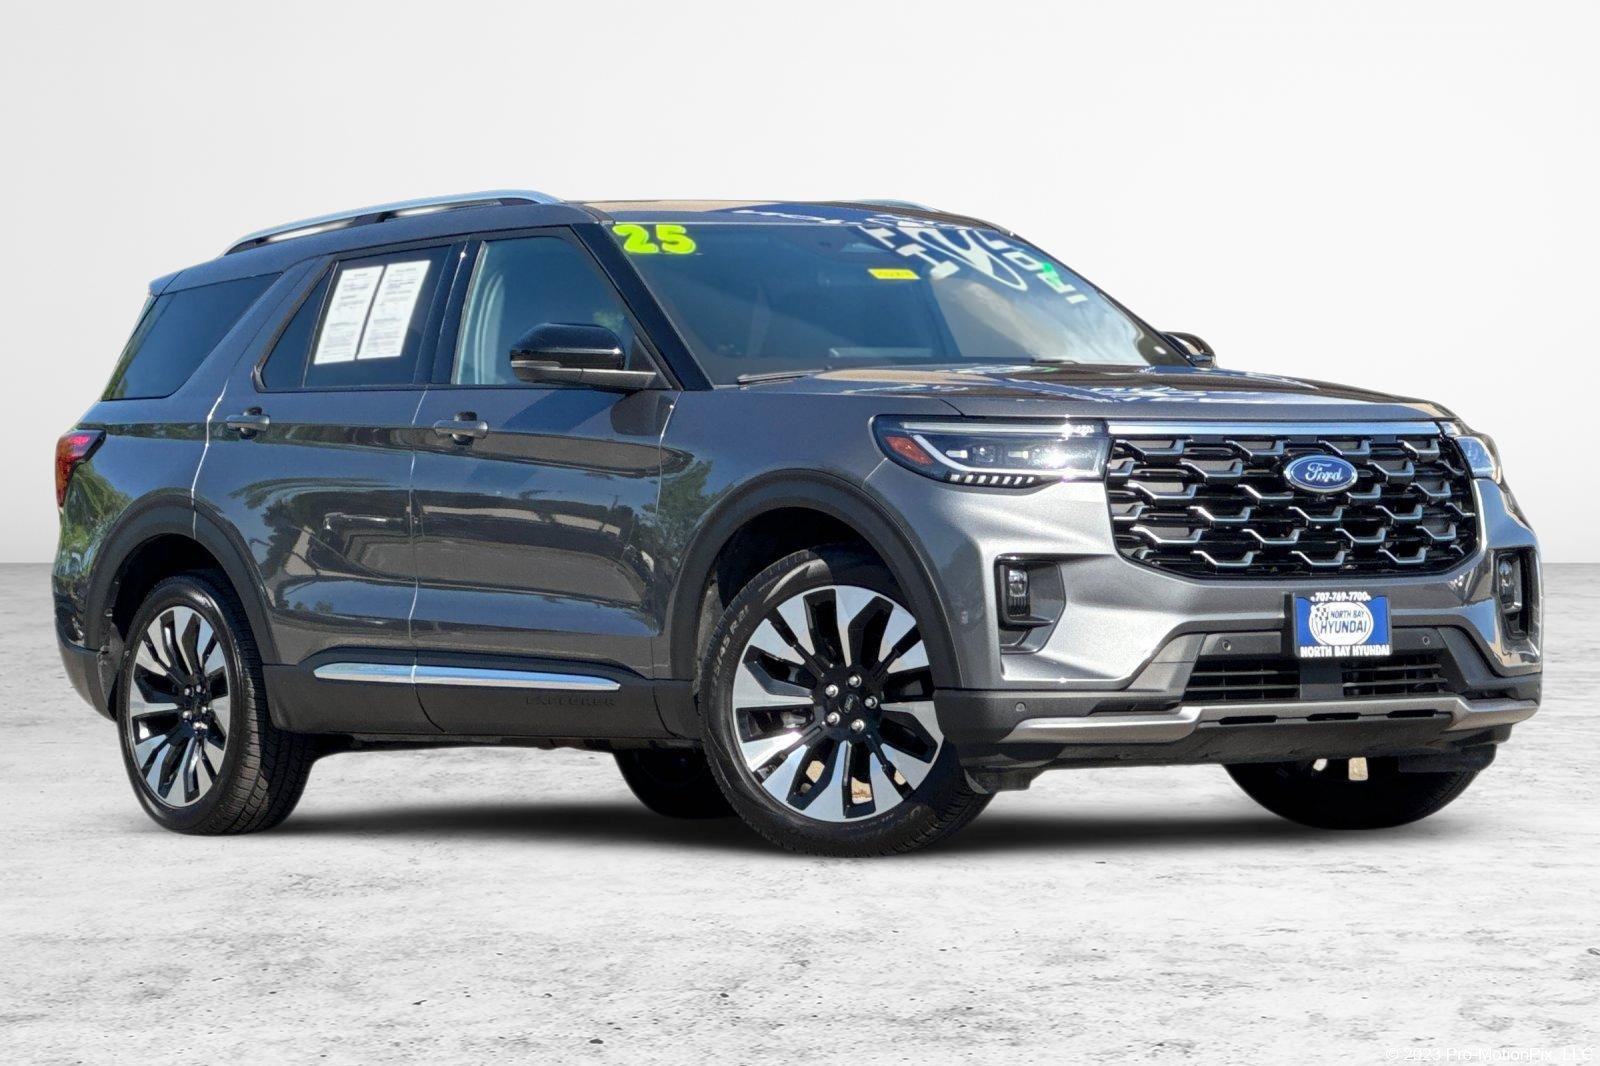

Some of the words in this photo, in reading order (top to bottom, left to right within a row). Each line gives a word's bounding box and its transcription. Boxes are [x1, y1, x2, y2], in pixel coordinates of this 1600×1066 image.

[612, 224, 697, 254] 25
[1305, 462, 1343, 482] Ford
[1330, 610, 1351, 618] NORTH
[1320, 620, 1367, 634] HYUNDAI
[1300, 646, 1332, 658] NORTH
[1335, 646, 1350, 657] BAY
[1352, 645, 1390, 656] HYUNDAI
